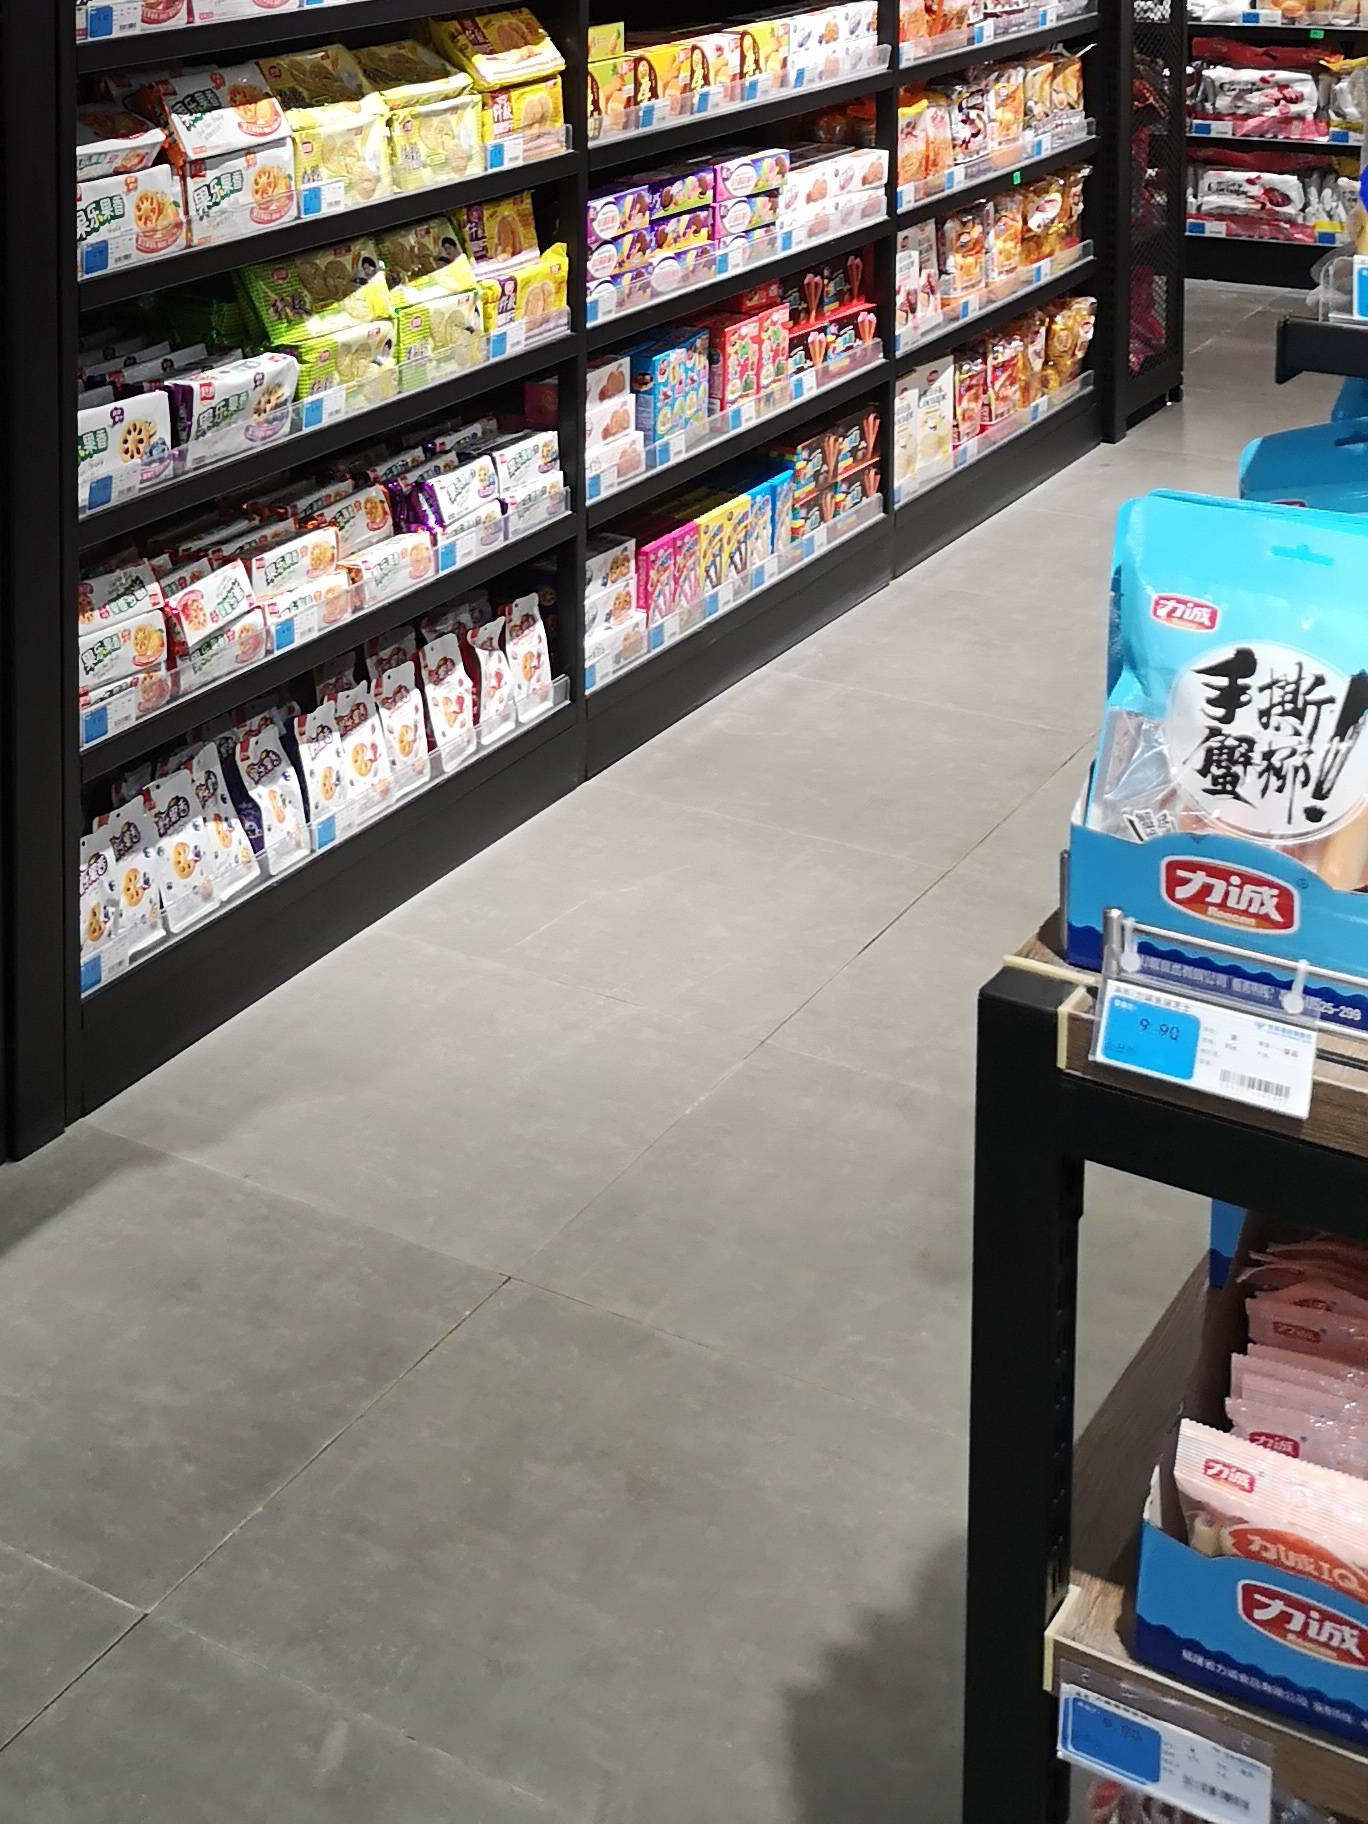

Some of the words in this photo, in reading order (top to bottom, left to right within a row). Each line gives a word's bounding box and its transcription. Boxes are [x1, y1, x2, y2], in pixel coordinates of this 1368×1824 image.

[1155, 598, 1213, 626] 力诚
[1174, 868, 1285, 922] 力诚
[1206, 1460, 1250, 1488] 力诚
[1252, 1592, 1367, 1661] 力诚
